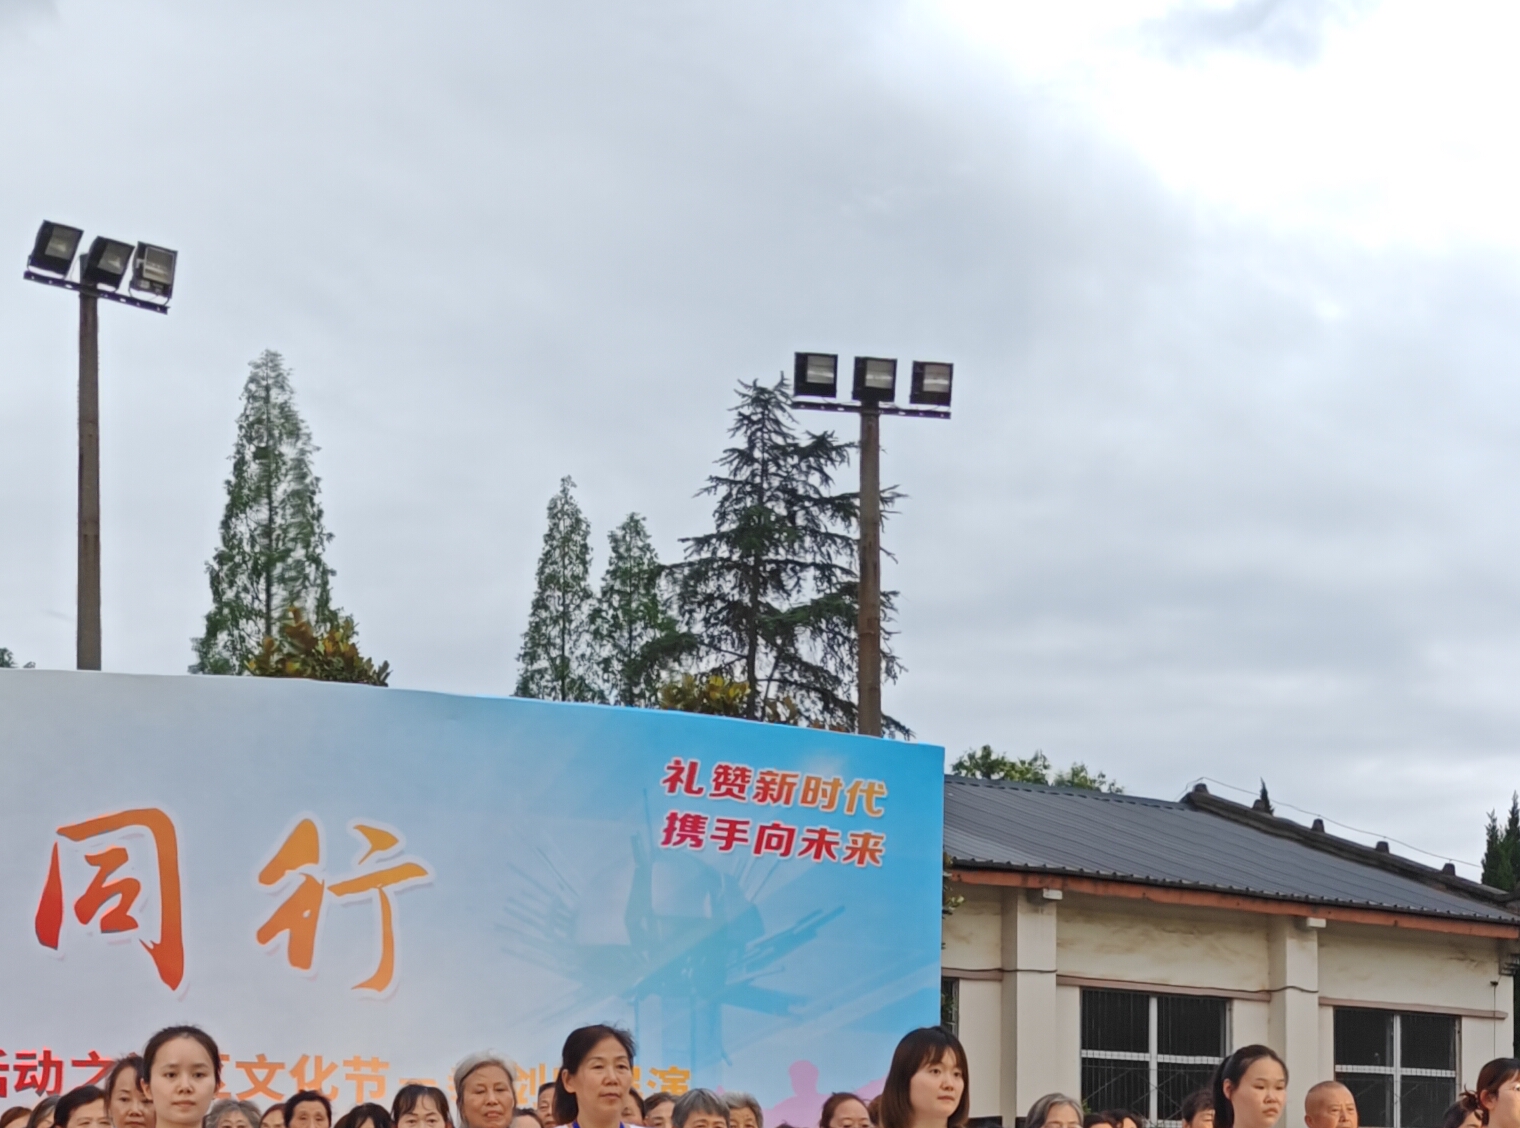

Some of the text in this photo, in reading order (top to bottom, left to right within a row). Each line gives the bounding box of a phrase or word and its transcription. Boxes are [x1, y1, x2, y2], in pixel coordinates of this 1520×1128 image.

[662, 759, 886, 815] 礼赞新时代
[661, 812, 884, 865] 携手向未来
